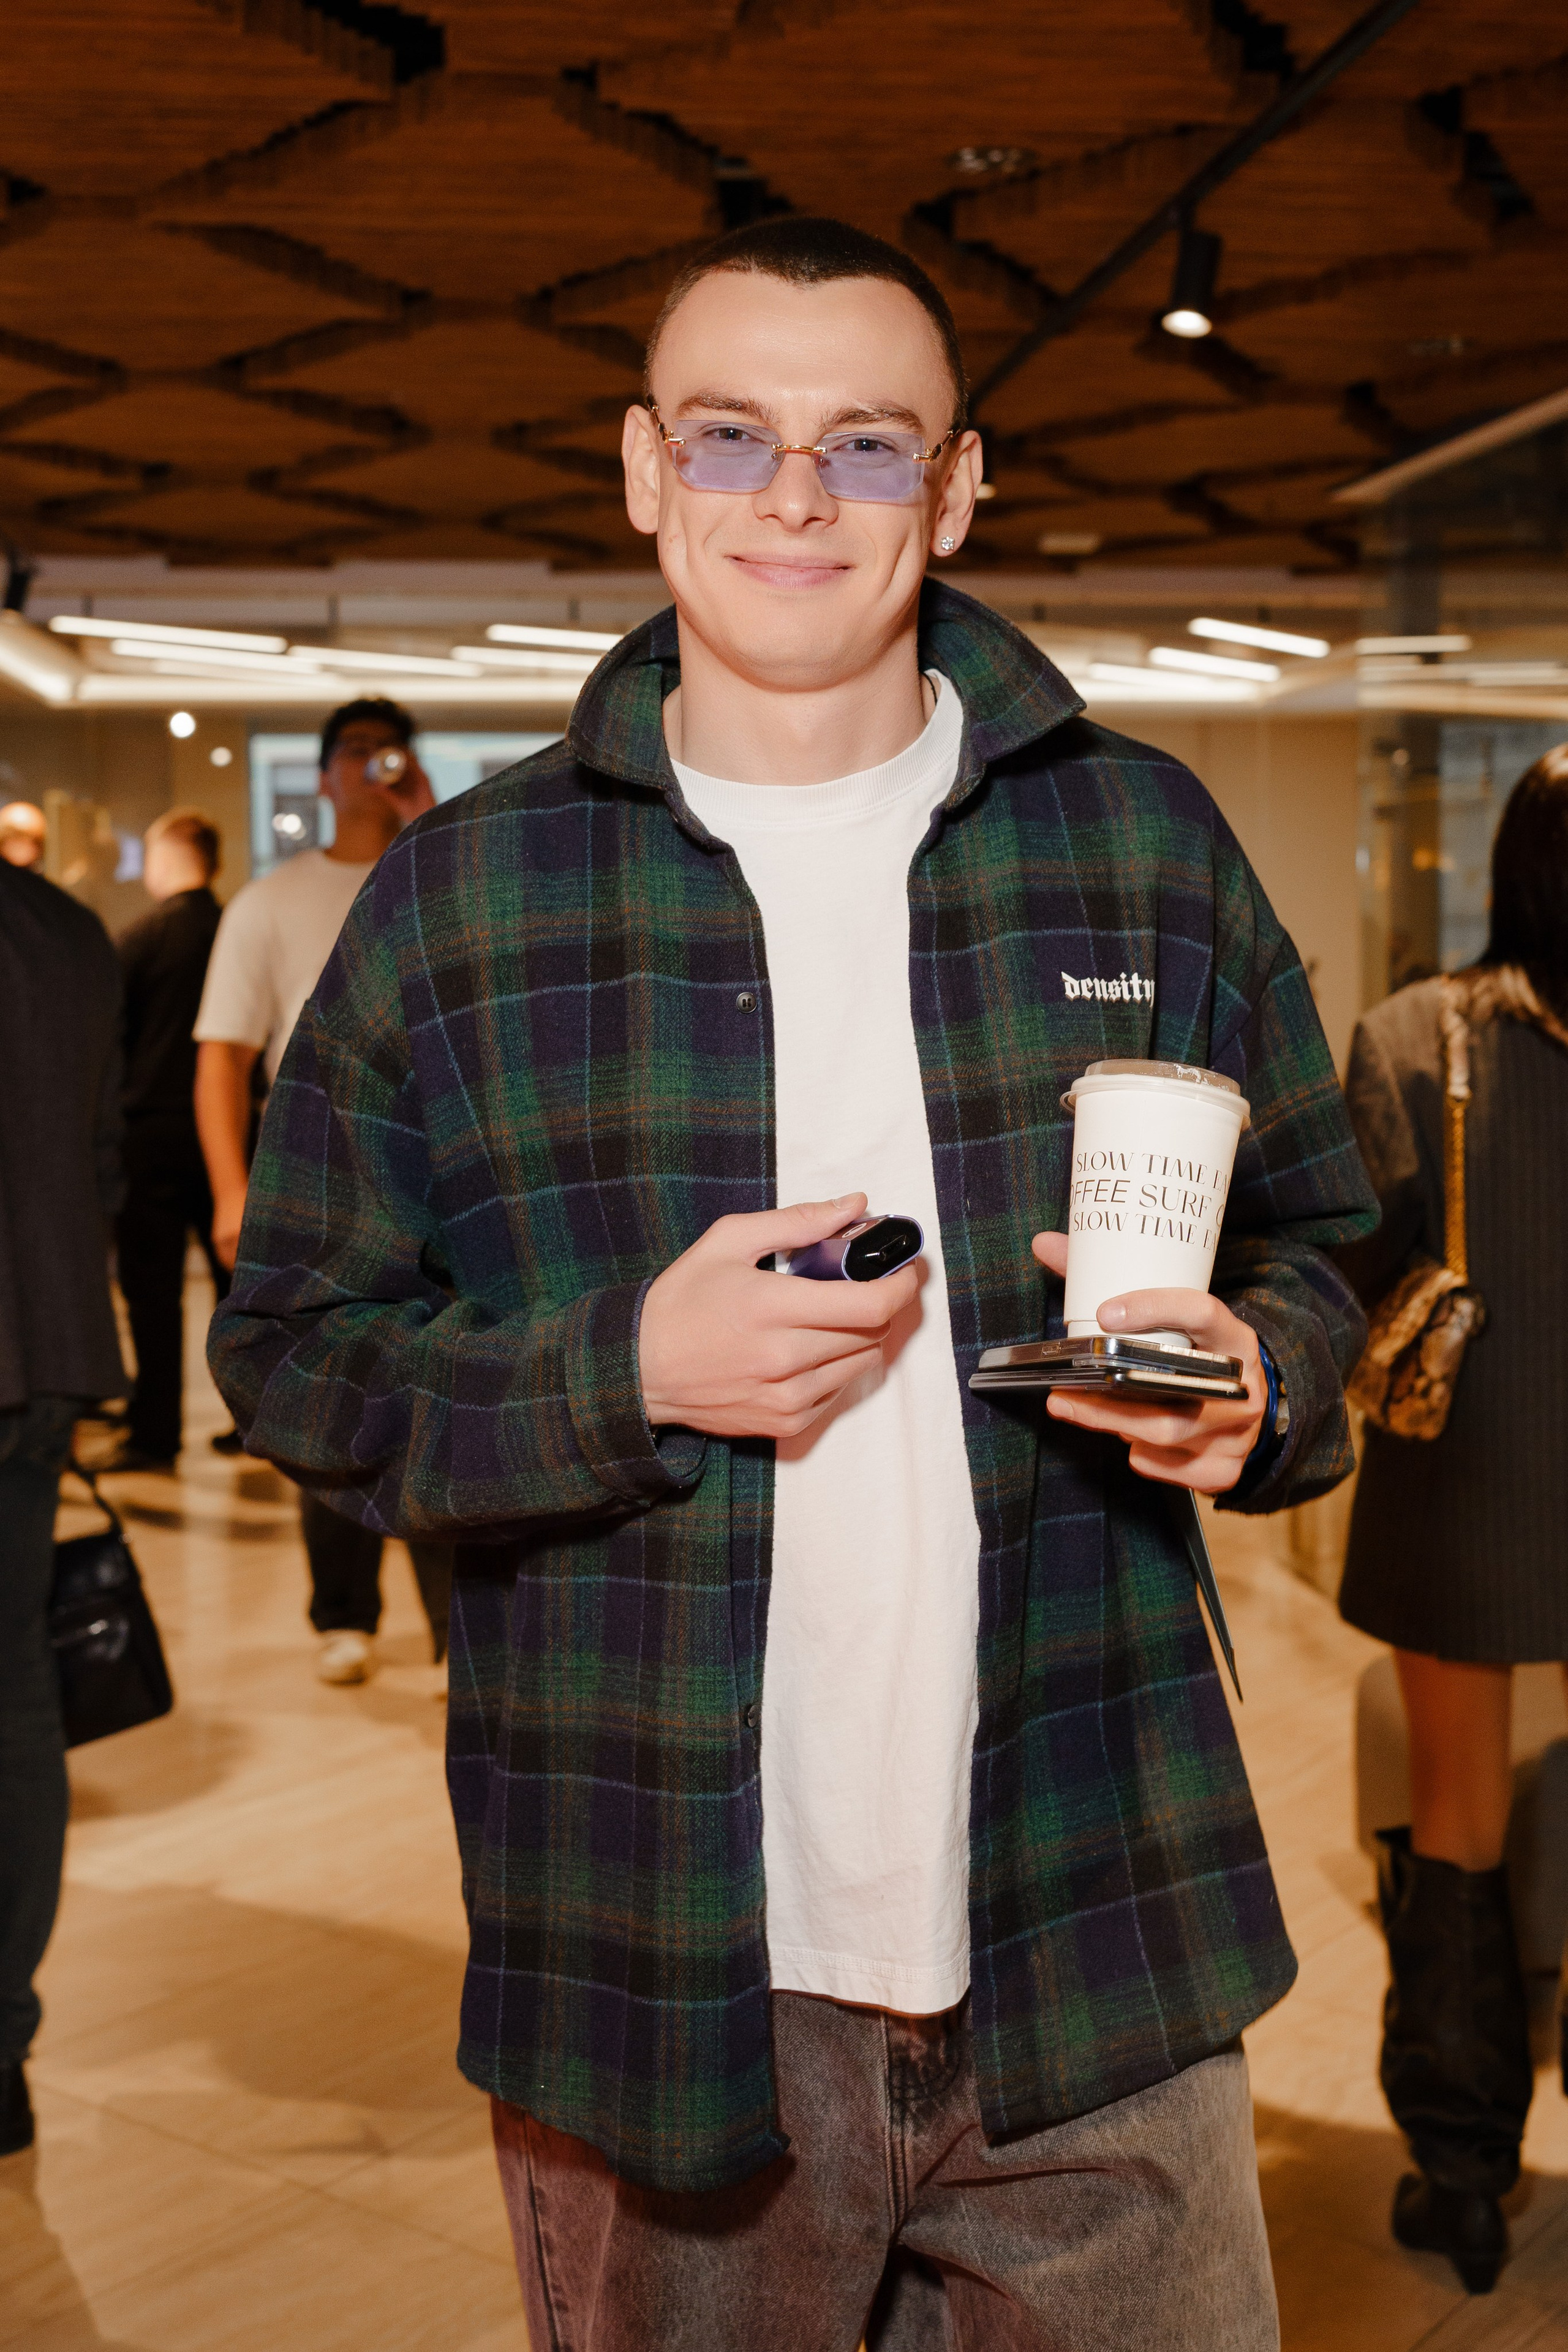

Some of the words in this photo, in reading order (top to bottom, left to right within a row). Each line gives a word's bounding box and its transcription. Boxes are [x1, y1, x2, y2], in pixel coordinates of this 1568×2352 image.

[1061, 971, 1155, 1009] density
[1076, 1151, 1134, 1172] SLOW
[1141, 1153, 1207, 1185] TIME
[1213, 1169, 1231, 1194] EA
[1139, 1183, 1212, 1218] SURF
[1074, 1210, 1129, 1232] SLOW
[1134, 1213, 1197, 1245] TIME
